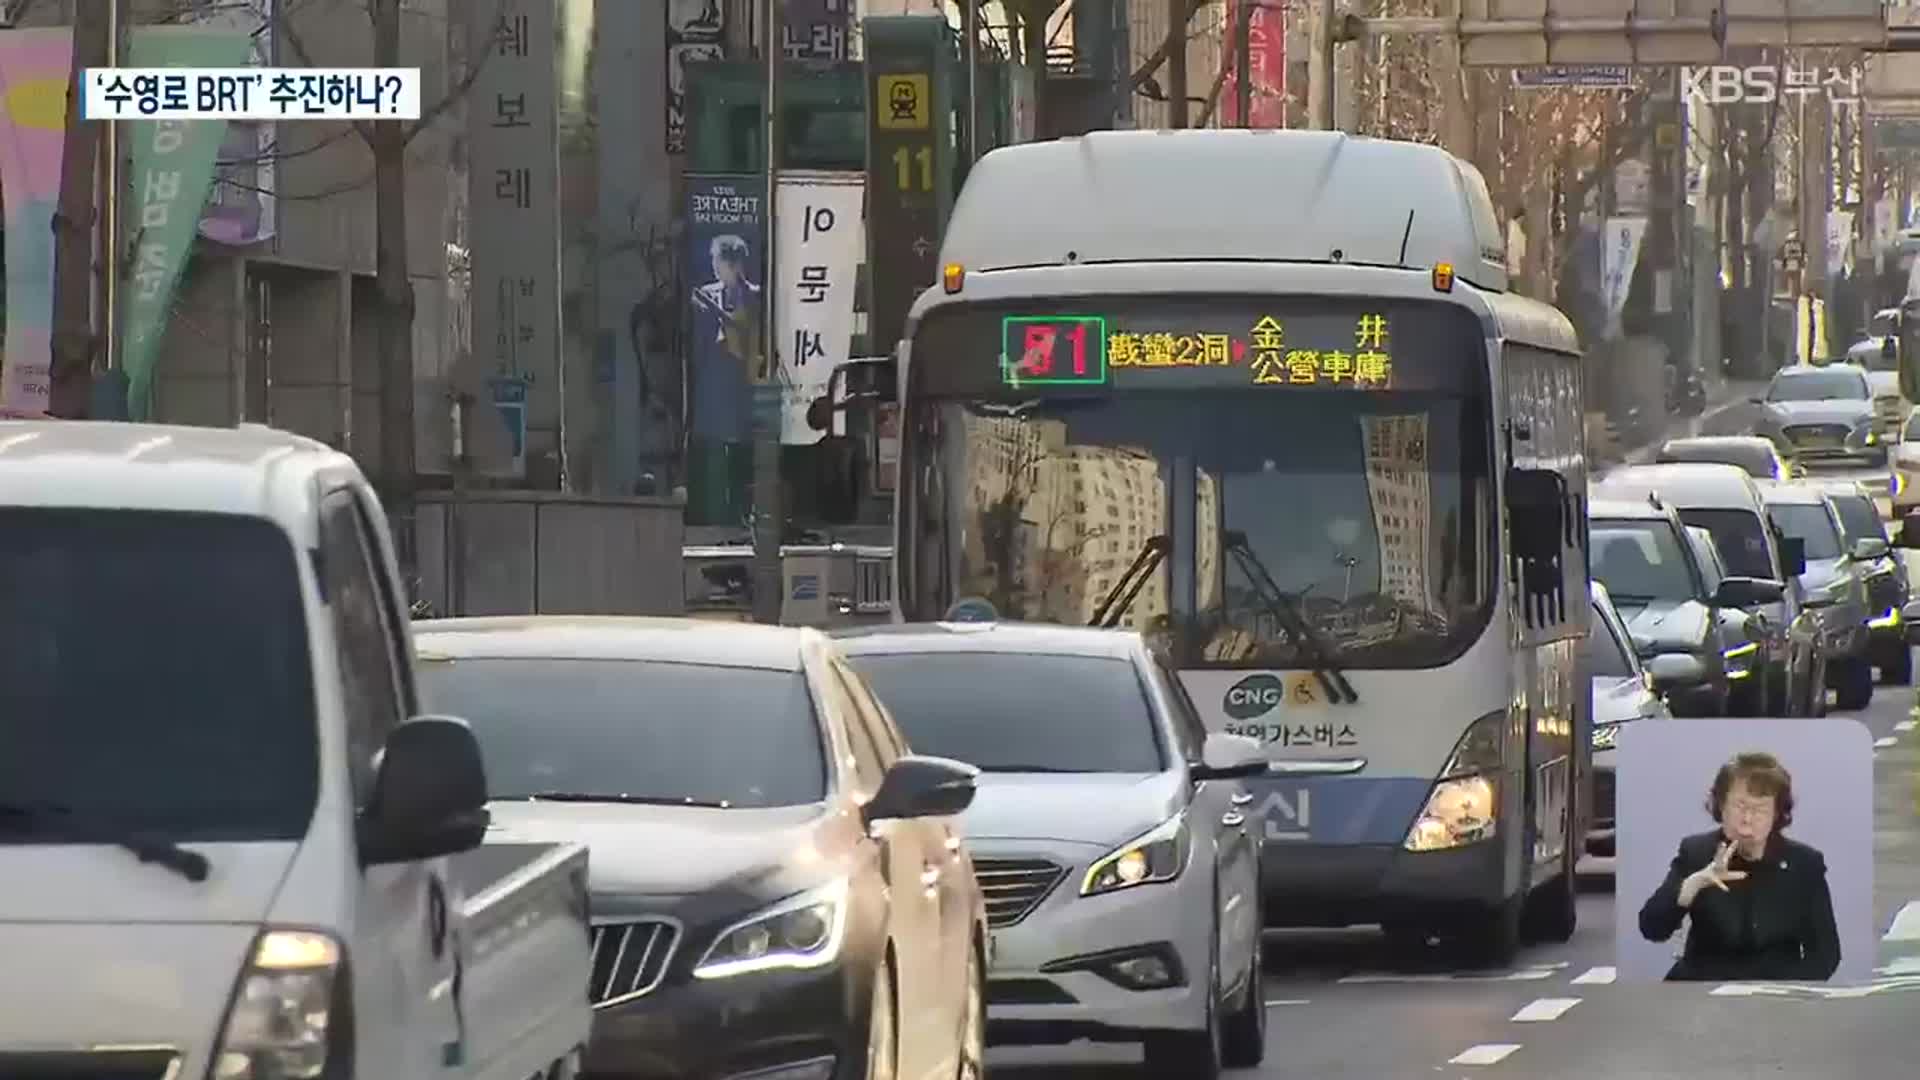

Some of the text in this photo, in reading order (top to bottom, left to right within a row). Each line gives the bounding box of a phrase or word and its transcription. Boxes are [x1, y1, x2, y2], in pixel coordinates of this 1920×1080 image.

[783, 25, 844, 61] 노래
[893, 147, 932, 190] 11
[1249, 314, 1389, 348] 金 井
[1250, 350, 1390, 384] 公營車庫
[1230, 688, 1279, 704] CNG
